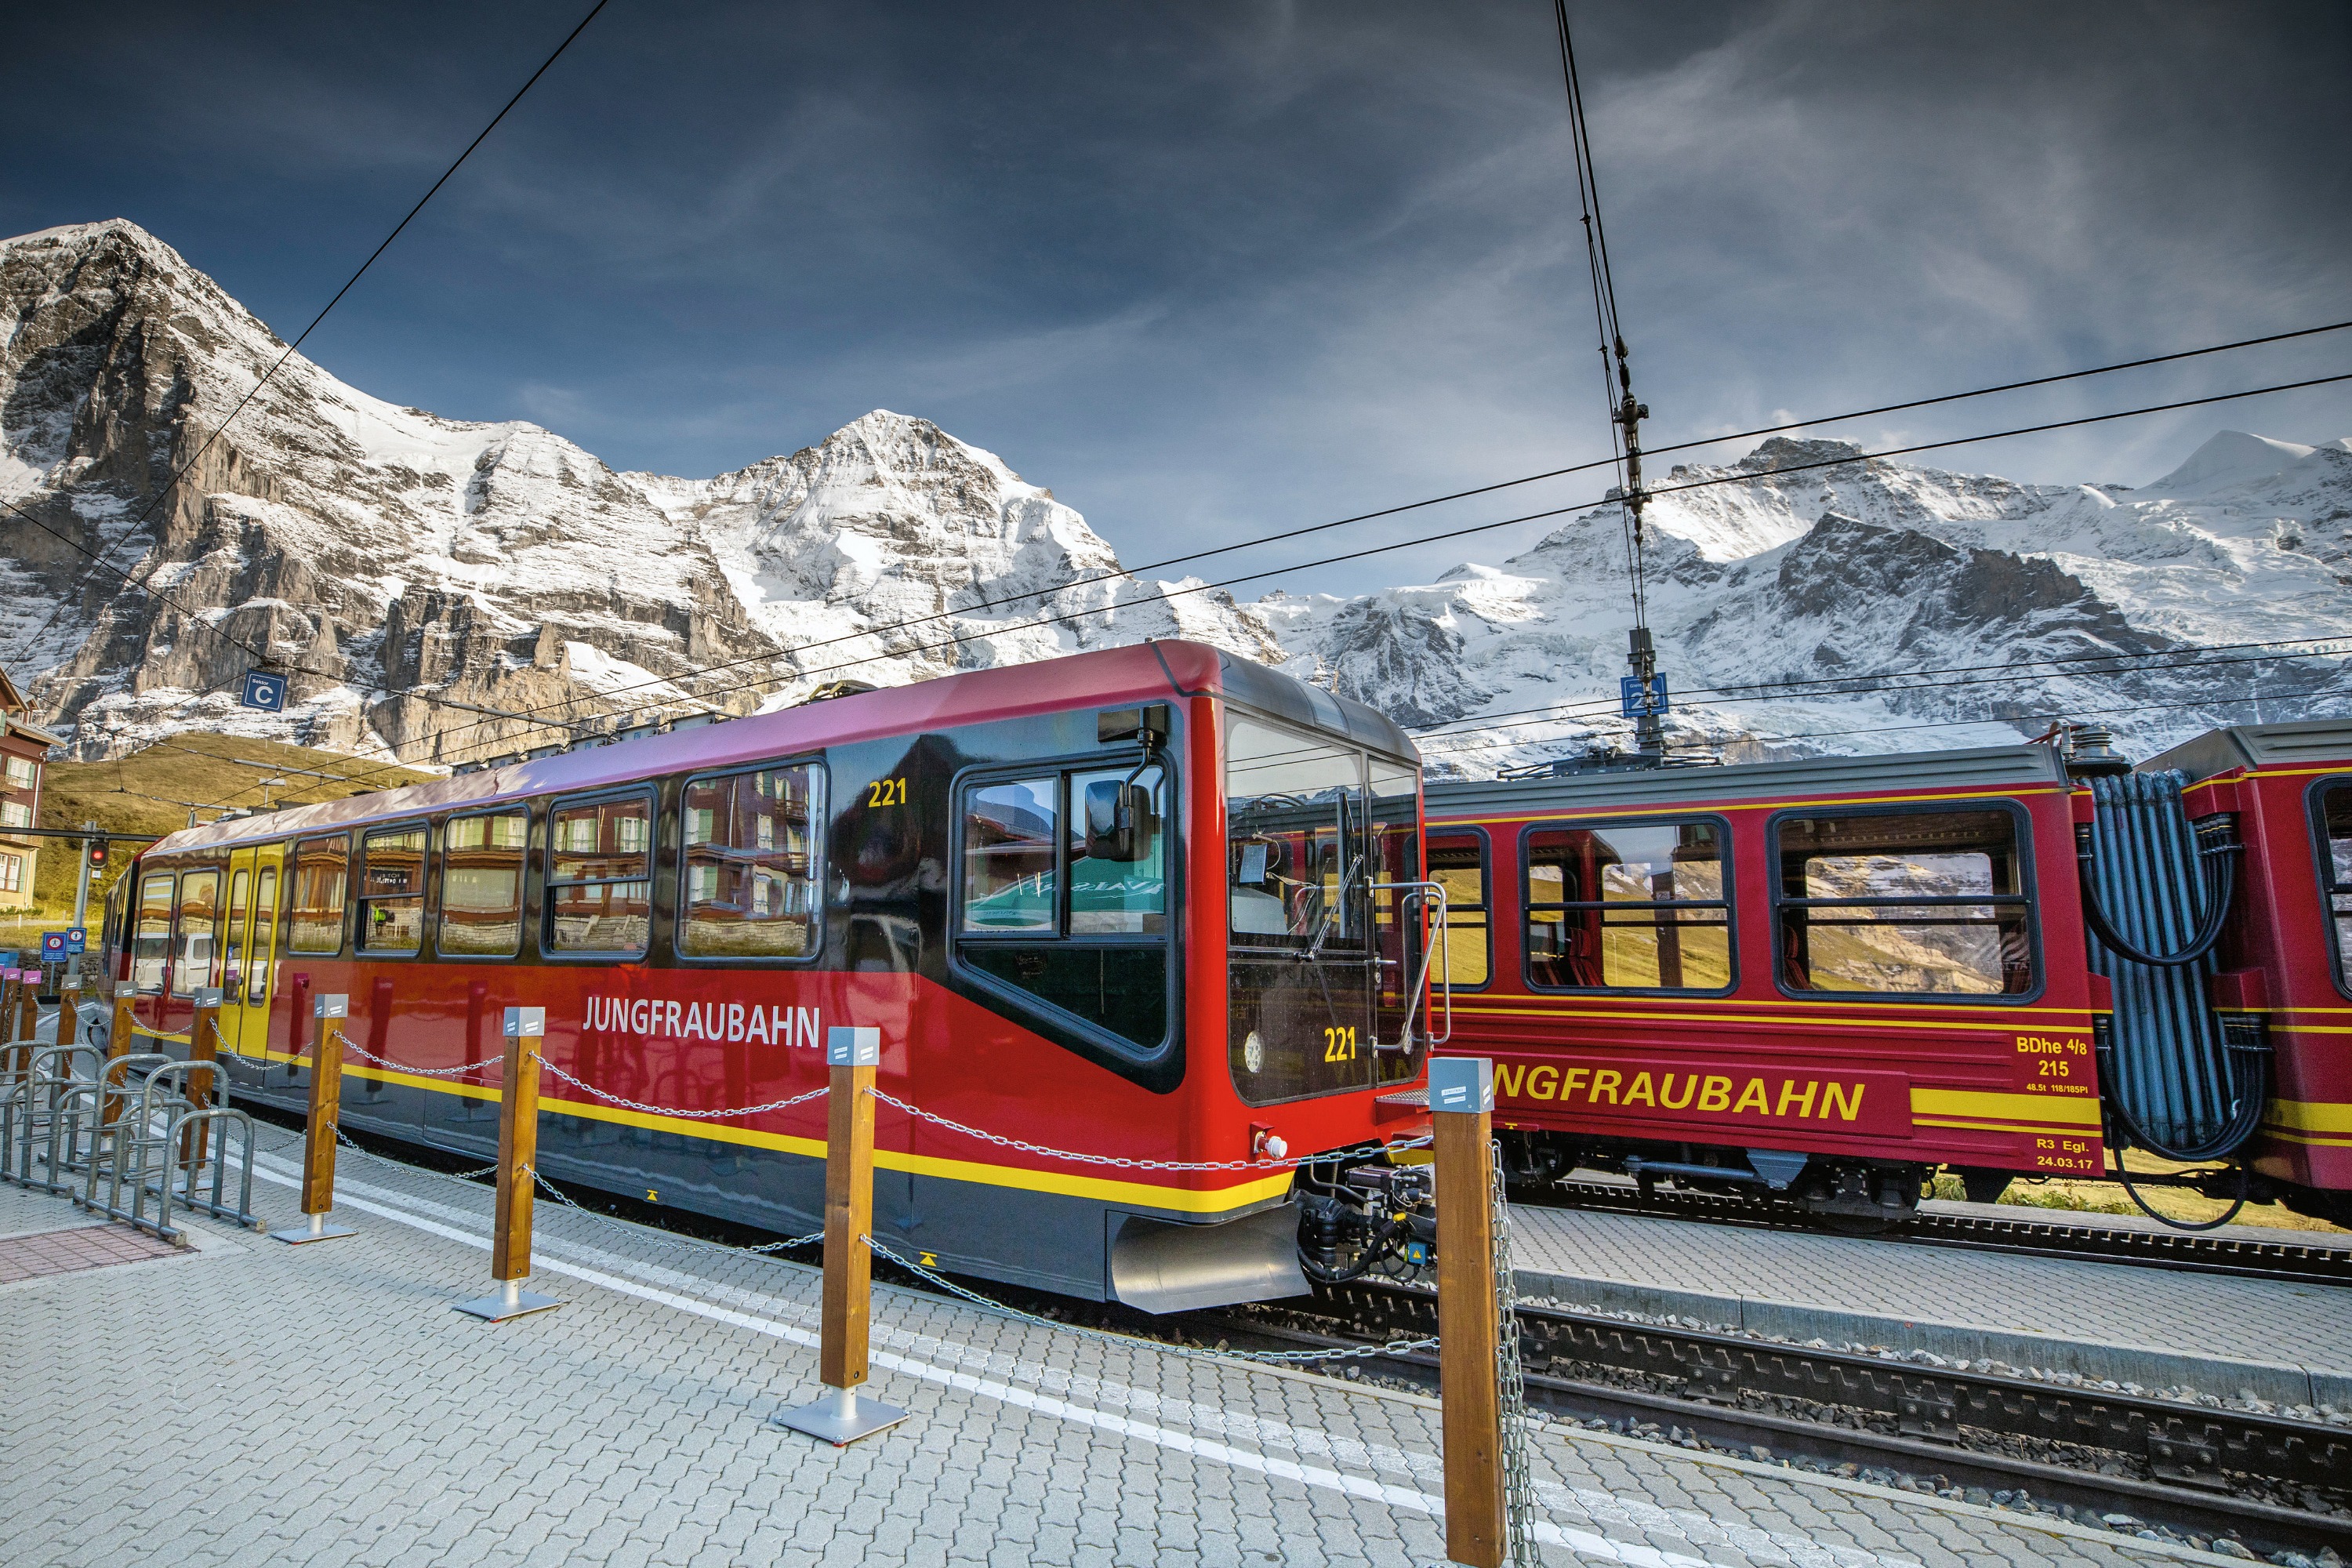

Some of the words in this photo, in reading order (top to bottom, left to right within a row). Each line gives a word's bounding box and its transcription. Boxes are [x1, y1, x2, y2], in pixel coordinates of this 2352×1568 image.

[256, 685, 274, 704] C
[868, 777, 906, 808] 221
[583, 996, 820, 1048] JUNGFRAUBAHN
[1324, 1026, 1356, 1063] 221
[2016, 1036, 2063, 1054] BDhe
[2067, 1038, 2088, 1055] 4/8
[2038, 1059, 2070, 1077] 215
[1493, 1063, 1865, 1121] NGFRAUBAHN
[2027, 1083, 2046, 1092] 48.5t
[2036, 1138, 2055, 1149] R3
[2063, 1140, 2089, 1153] Egl.
[2037, 1156, 2093, 1169] 24.03.17
